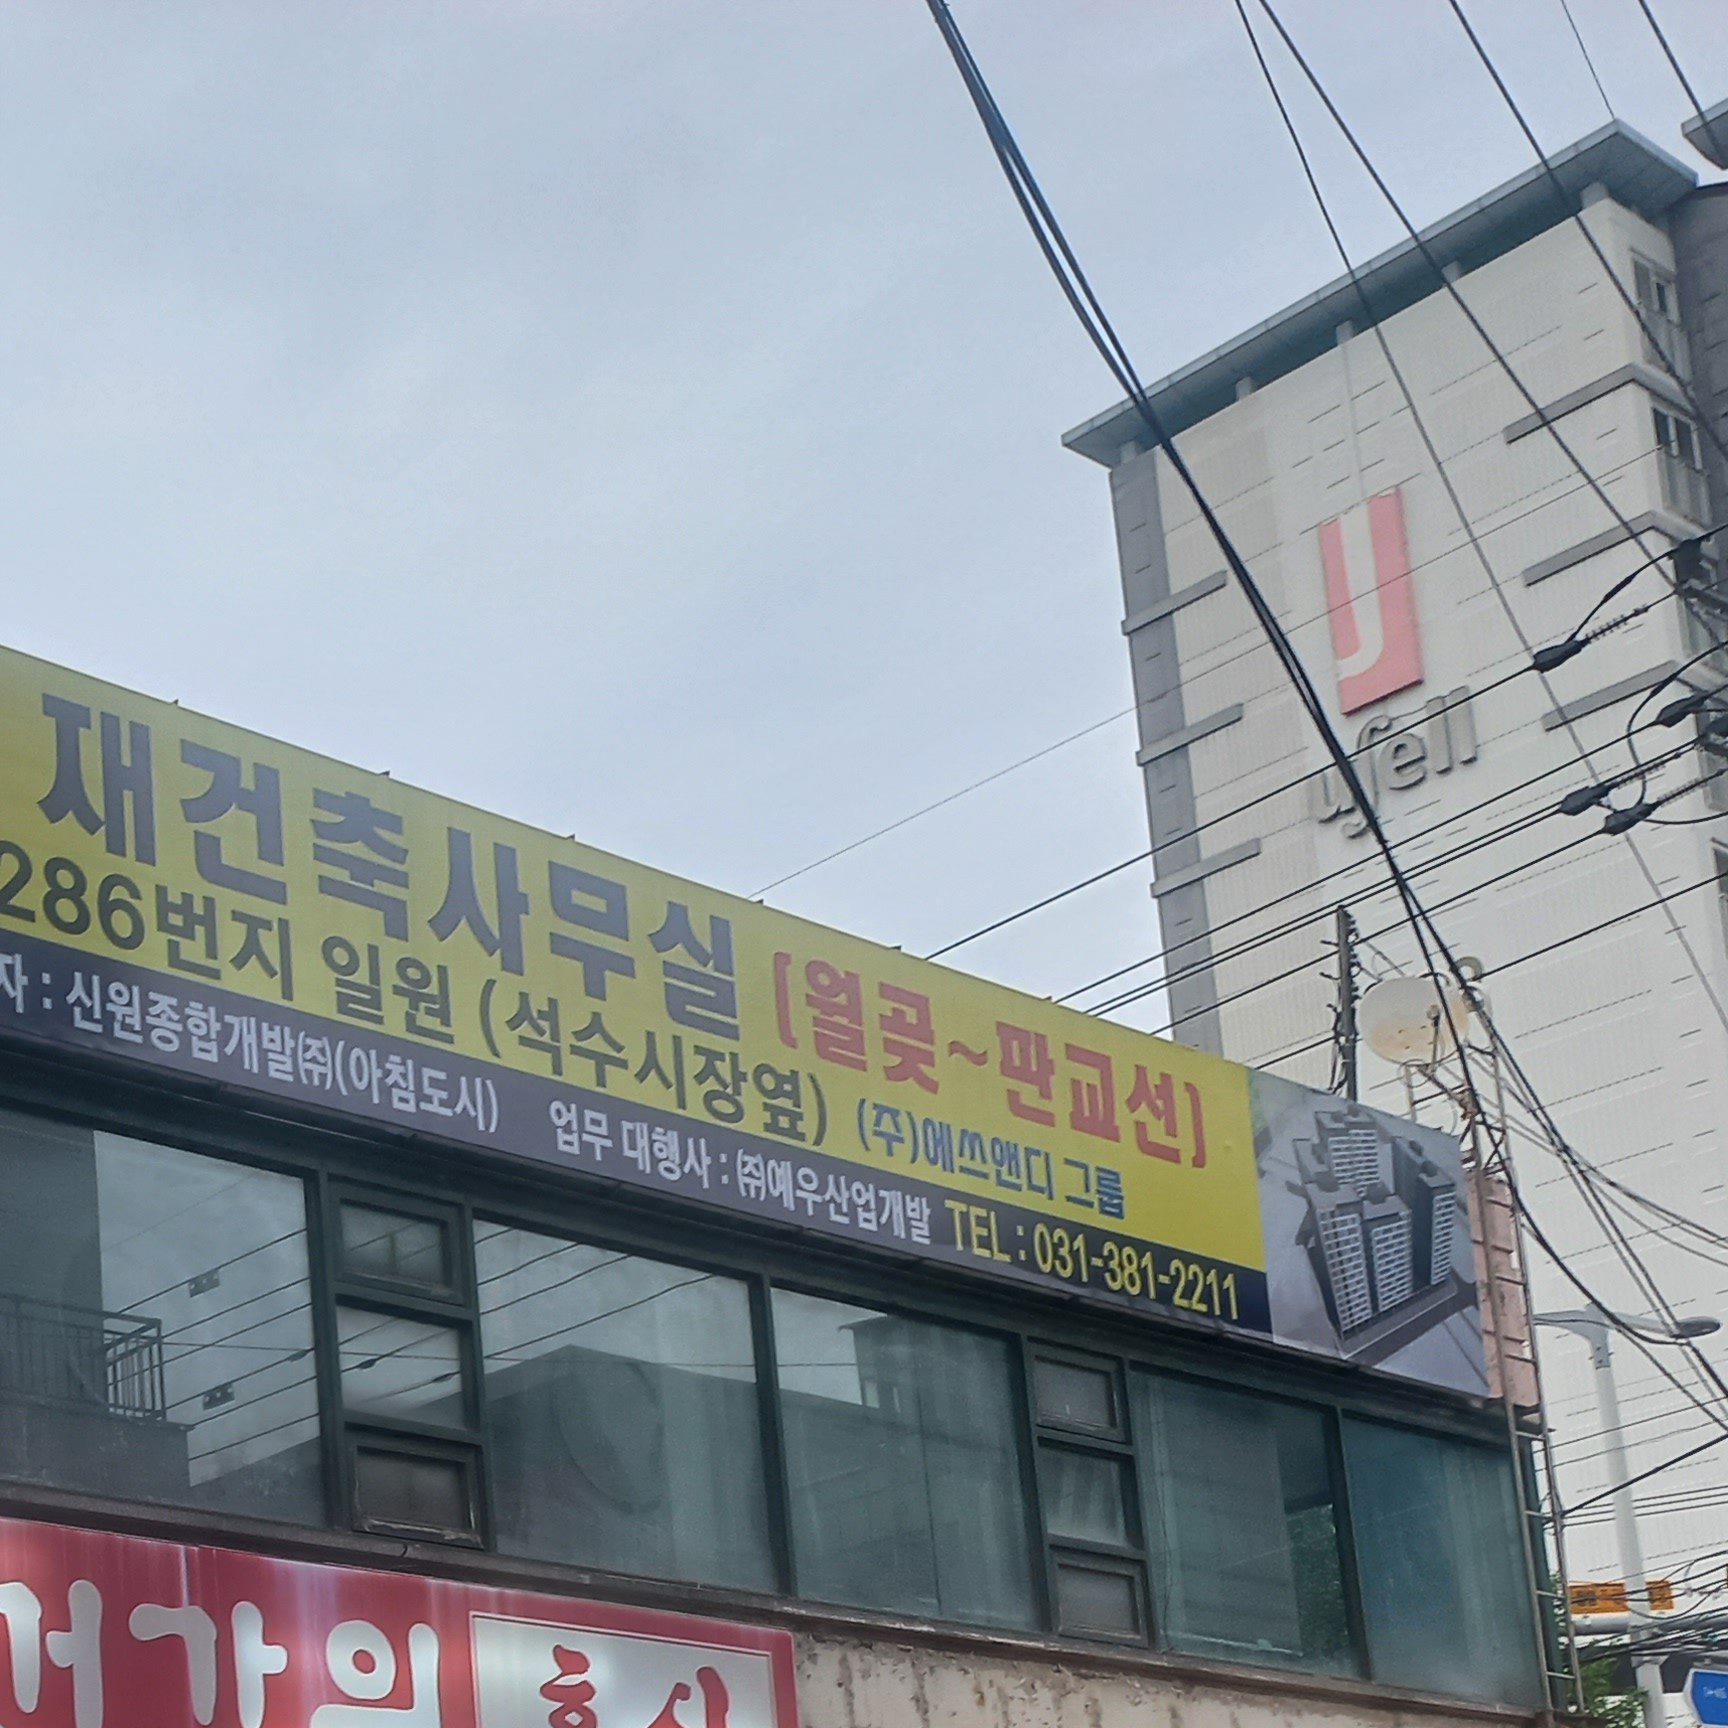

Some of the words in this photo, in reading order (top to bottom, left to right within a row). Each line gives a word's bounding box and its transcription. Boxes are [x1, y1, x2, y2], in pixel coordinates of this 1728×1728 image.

[38, 692, 741, 1041] 재건축사무실
[321, 935, 456, 1045] 일원
[480, 978, 827, 1147] (석수시장옆)
[1065, 1156, 1125, 1219] 그룹
[549, 1099, 614, 1162] 업무
[622, 1119, 712, 1190] 대행사
[946, 1207, 1011, 1266] TEL
[1033, 1226, 1241, 1323] 031-381-2211
